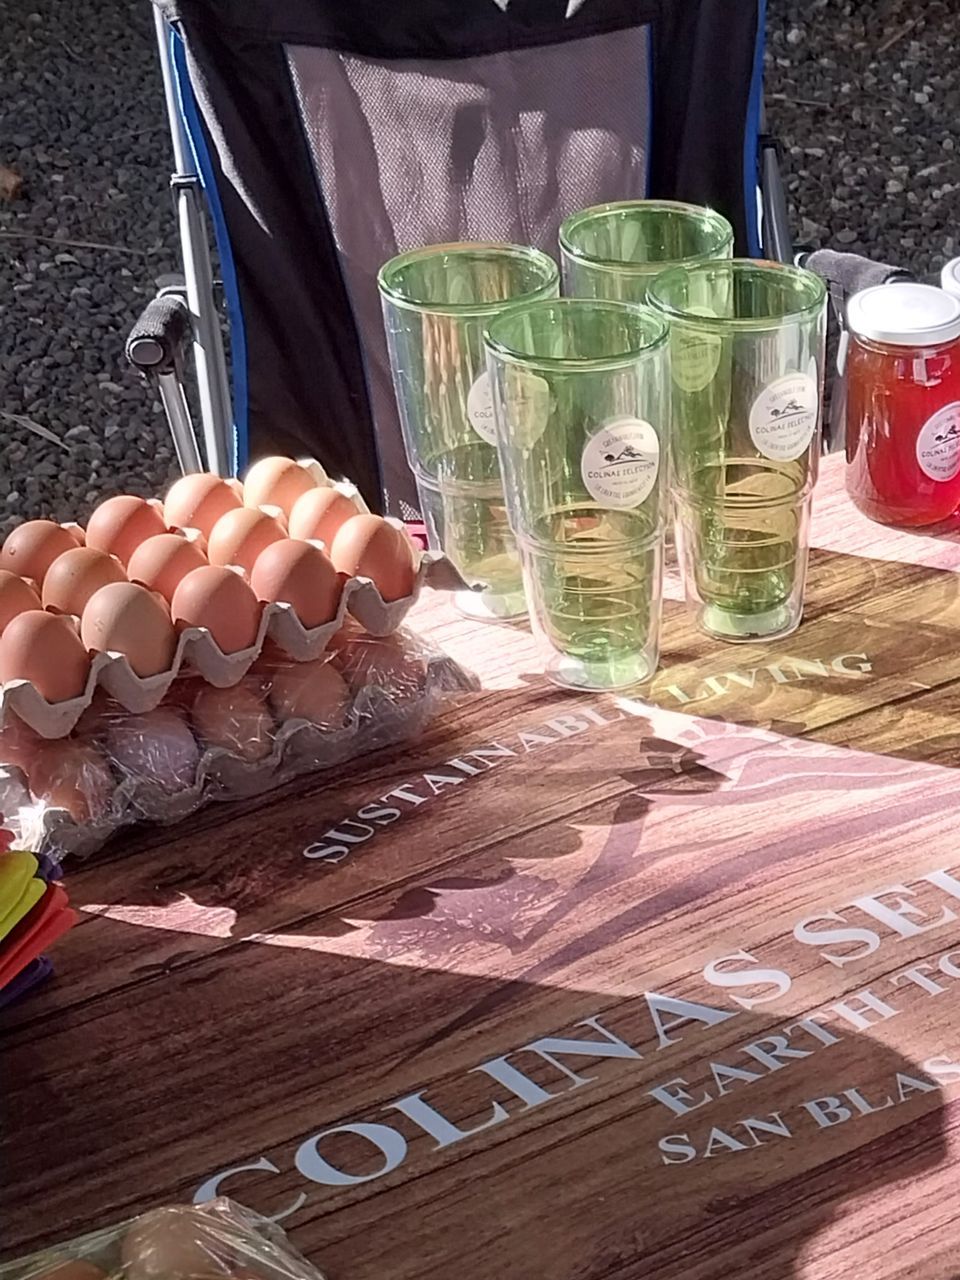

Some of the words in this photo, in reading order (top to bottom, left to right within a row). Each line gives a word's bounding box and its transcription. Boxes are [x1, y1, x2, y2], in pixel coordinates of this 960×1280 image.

[303, 697, 650, 863] SUSTAINABL
[665, 652, 873, 704] LIVING
[194, 949, 792, 1222] COLINAS
[648, 989, 904, 1118] EARTH
[657, 1112, 793, 1165] SAN
